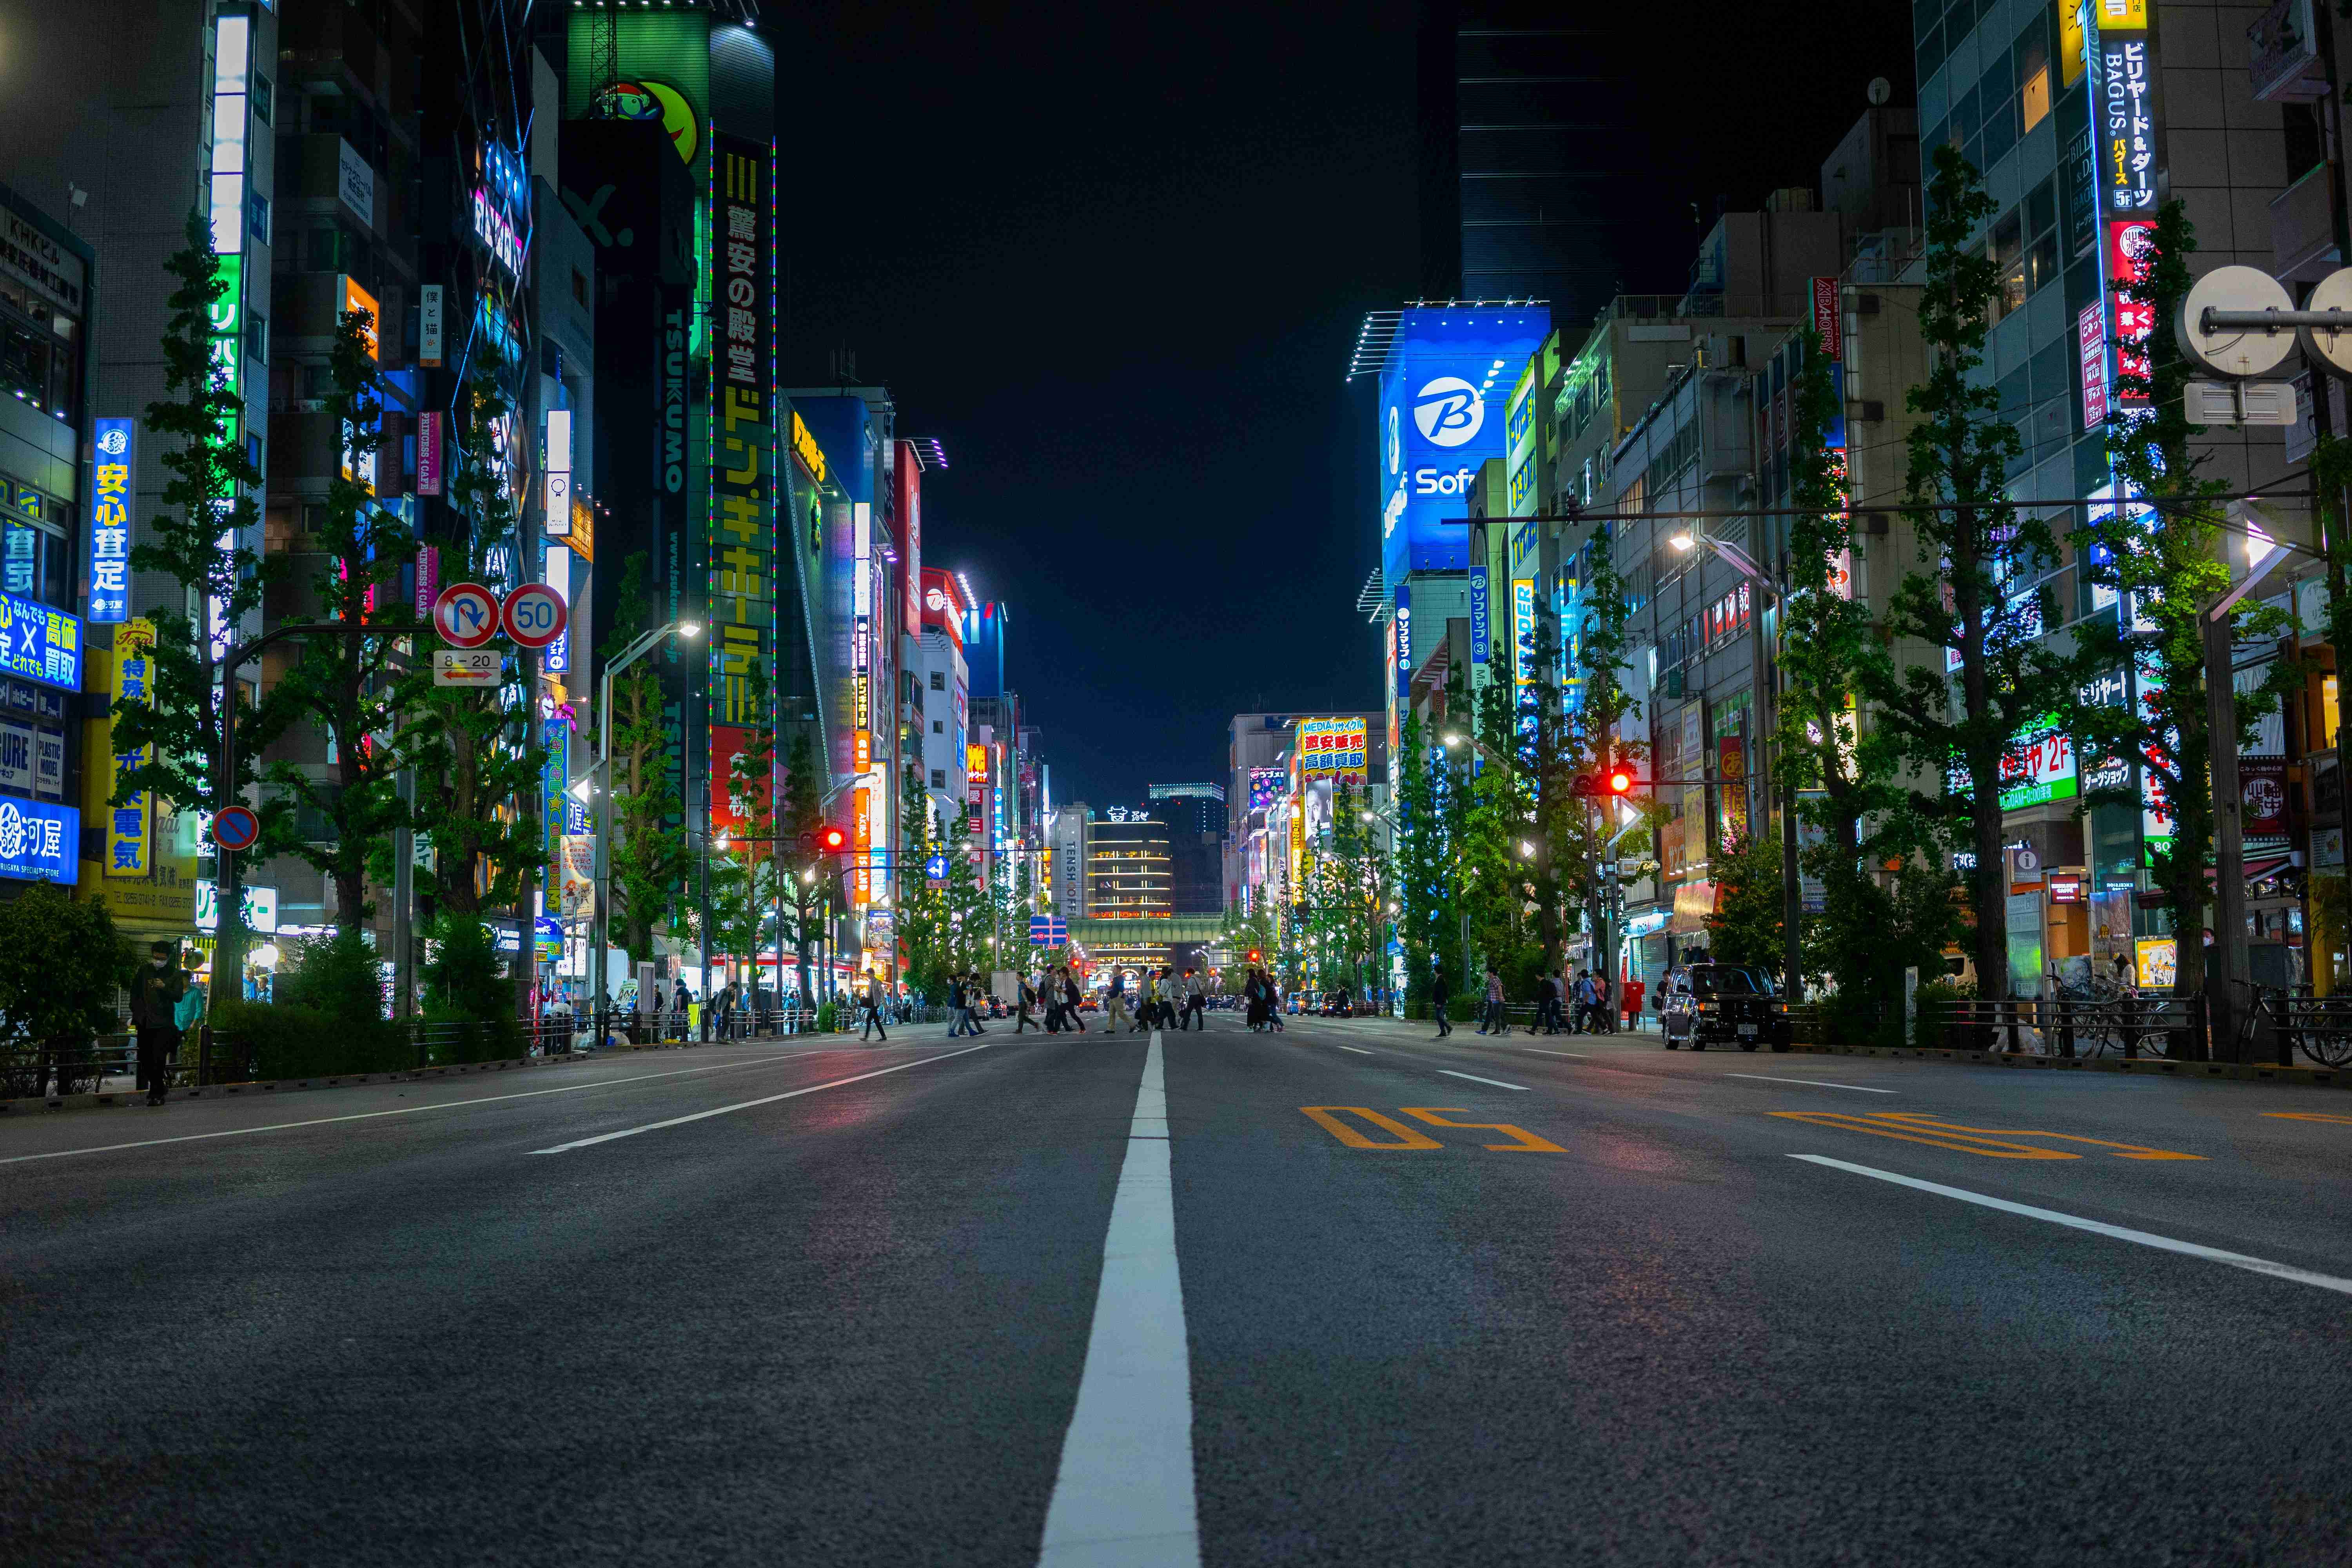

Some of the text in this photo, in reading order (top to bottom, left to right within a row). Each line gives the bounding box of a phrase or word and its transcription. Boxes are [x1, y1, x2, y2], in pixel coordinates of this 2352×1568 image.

[2107, 54, 2126, 129] BAGUS
[2126, 43, 2152, 207] ビリヤード&ダーツ
[2114, 139, 2128, 185] バグース
[2116, 191, 2130, 206] 5F
[426, 291, 438, 335] 僕と猫
[666, 309, 682, 493] TSUKUMO
[421, 412, 429, 456] PRINCESS
[1416, 468, 1475, 494] Sof
[93, 463, 128, 591] 安心査定
[14, 600, 45, 625] なんでも
[47, 612, 77, 652] 高価
[517, 602, 552, 629] 50
[1474, 592, 1485, 638] ソフマップ
[1517, 586, 1531, 681] TRDER
[1399, 621, 1410, 657] ソフマップ
[12, 654, 43, 677] どれでも
[45, 647, 75, 686] 買取
[0, 731, 29, 770] URE
[38, 740, 60, 760] PLASTIC
[1305, 735, 1363, 750] 激安販売
[1305, 753, 1364, 769] 高額買取
[2049, 735, 2068, 772] 2F
[41, 759, 58, 776] MODEL
[2085, 765, 2129, 791] ダーツショップ
[2154, 842, 2170, 852] 80
[0, 863, 59, 877] RUGAYA SPECIALTY STORE
[858, 856, 867, 891] ISLAND
